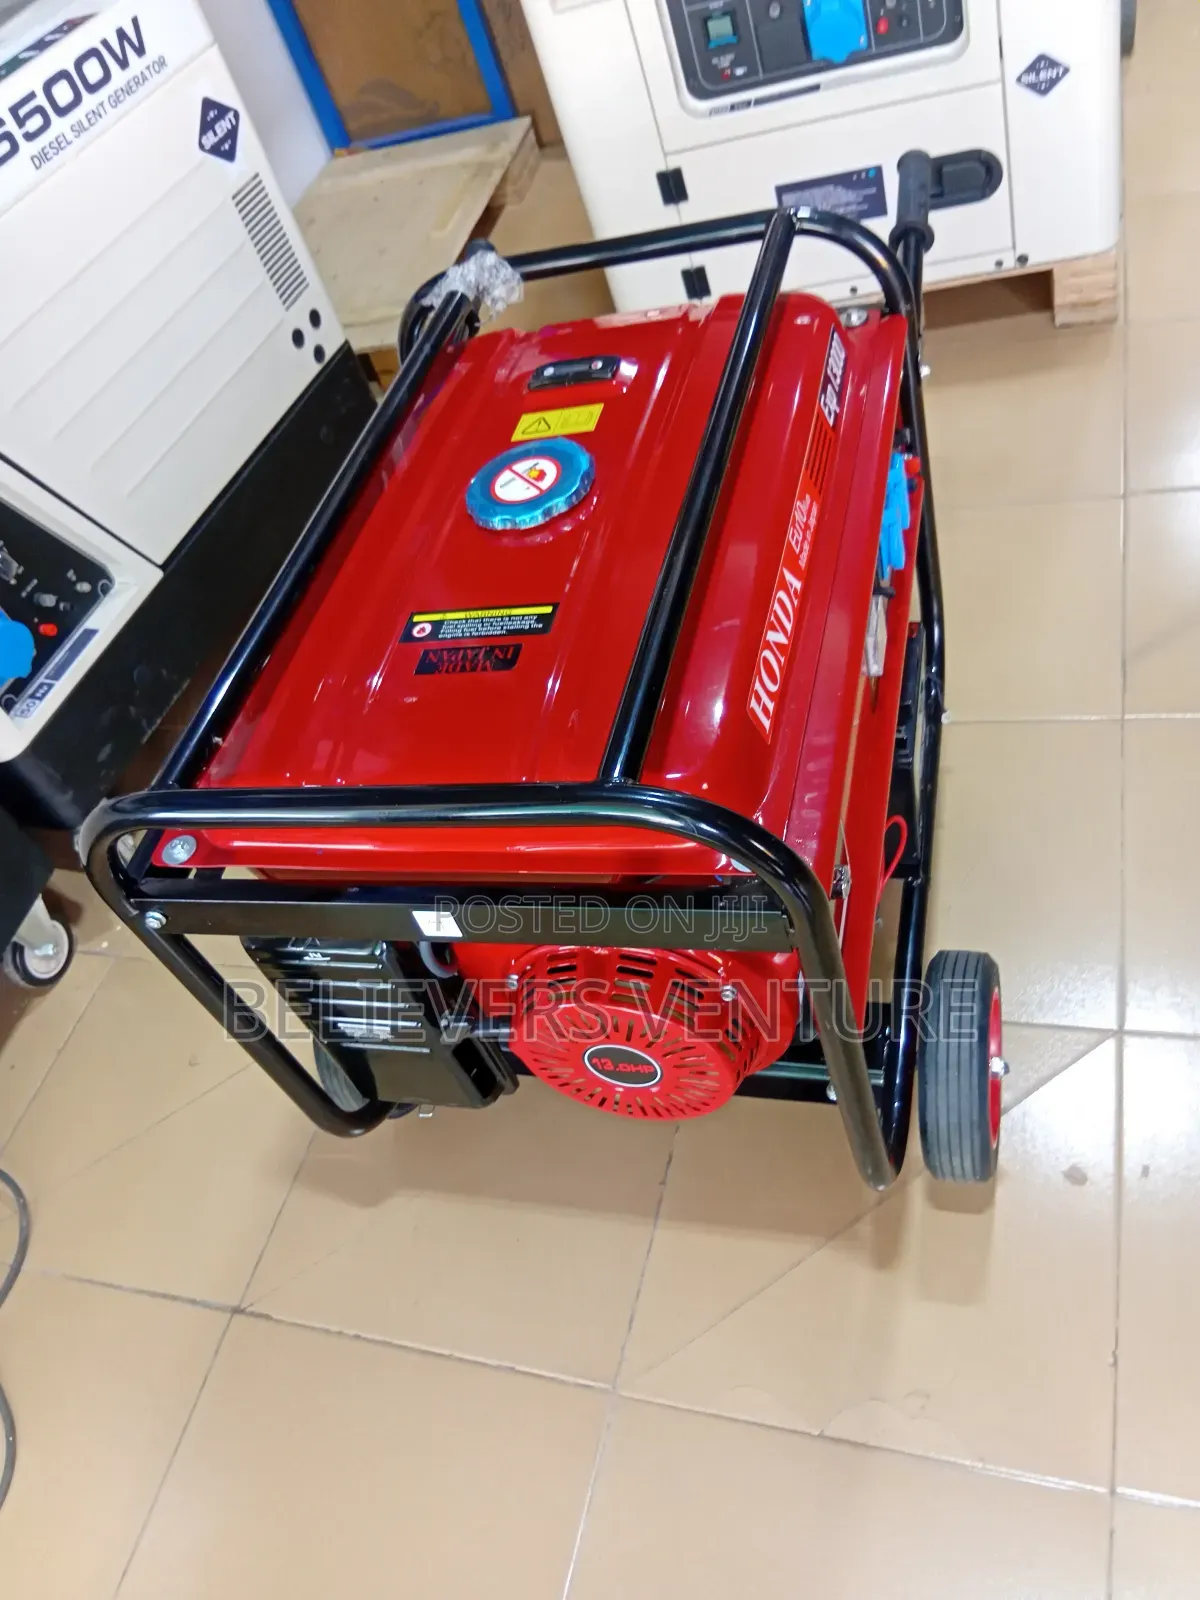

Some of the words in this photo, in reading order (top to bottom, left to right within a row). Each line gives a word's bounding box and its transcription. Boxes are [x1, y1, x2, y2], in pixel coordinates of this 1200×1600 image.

[30, 131, 73, 171] DIESEL
[70, 100, 108, 139] SILENT
[107, 54, 169, 109] GENERATOR
[201, 110, 236, 150] SILENT
[444, 618, 466, 626] Check
[483, 615, 502, 623] there
[426, 646, 490, 664] JAPAN
[492, 645, 515, 661] IN
[750, 566, 802, 735] HONDA
[592, 1057, 654, 1074] 13.0HP
